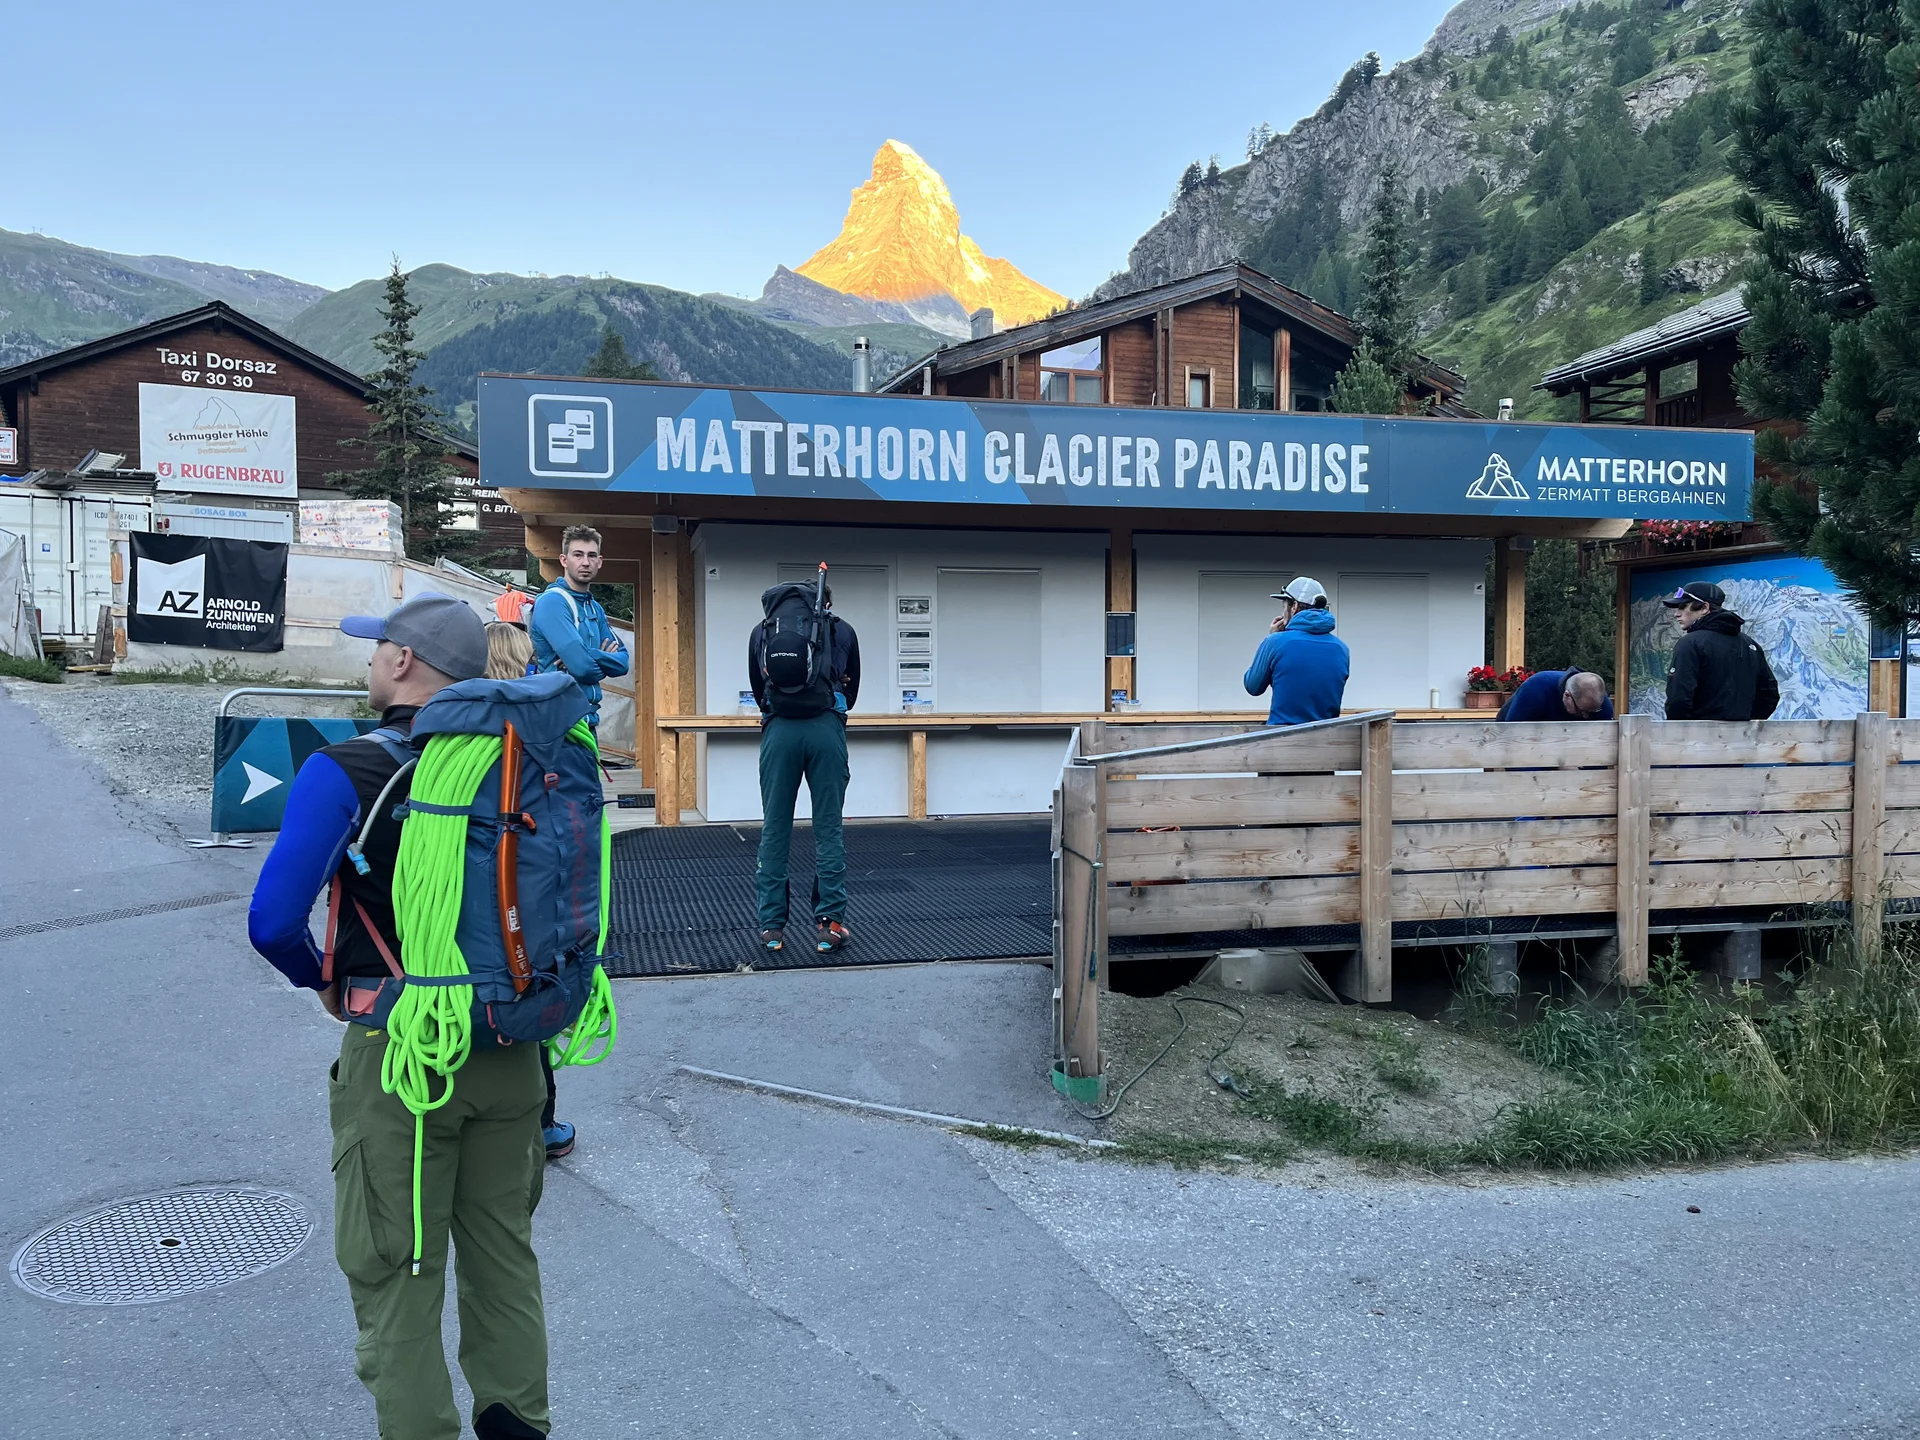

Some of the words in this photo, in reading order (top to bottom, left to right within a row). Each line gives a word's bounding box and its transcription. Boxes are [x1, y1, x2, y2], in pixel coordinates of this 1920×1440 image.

[156, 348, 197, 367] Taxi
[206, 353, 277, 374] Dorsaz
[181, 371, 200, 383] 67
[206, 373, 227, 385] 30
[232, 376, 253, 388] 30
[586, 414, 591, 422] 1
[168, 430, 233, 441] Schmuggler
[236, 429, 269, 438] Höhle
[568, 429, 575, 437] 2
[656, 416, 966, 482] MATTERHORN
[984, 430, 1160, 487] GLACIER
[1175, 438, 1369, 493] PARADISE
[180, 463, 285, 484] RUGENBRÄU
[1537, 455, 1726, 486] MATTERHORN
[1537, 486, 1611, 502] ZERMATT
[1617, 489, 1726, 505] BERGBAHNEN
[194, 507, 226, 516] SOSAG
[229, 510, 247, 518] BOX
[482, 503, 491, 512] G.
[494, 504, 517, 514] BITT
[119, 513, 138, 521] 87401
[157, 590, 199, 614] AZ
[206, 597, 261, 611] ARNOLD
[206, 608, 275, 624] ZURNIWEN
[206, 620, 257, 632] Architekten
